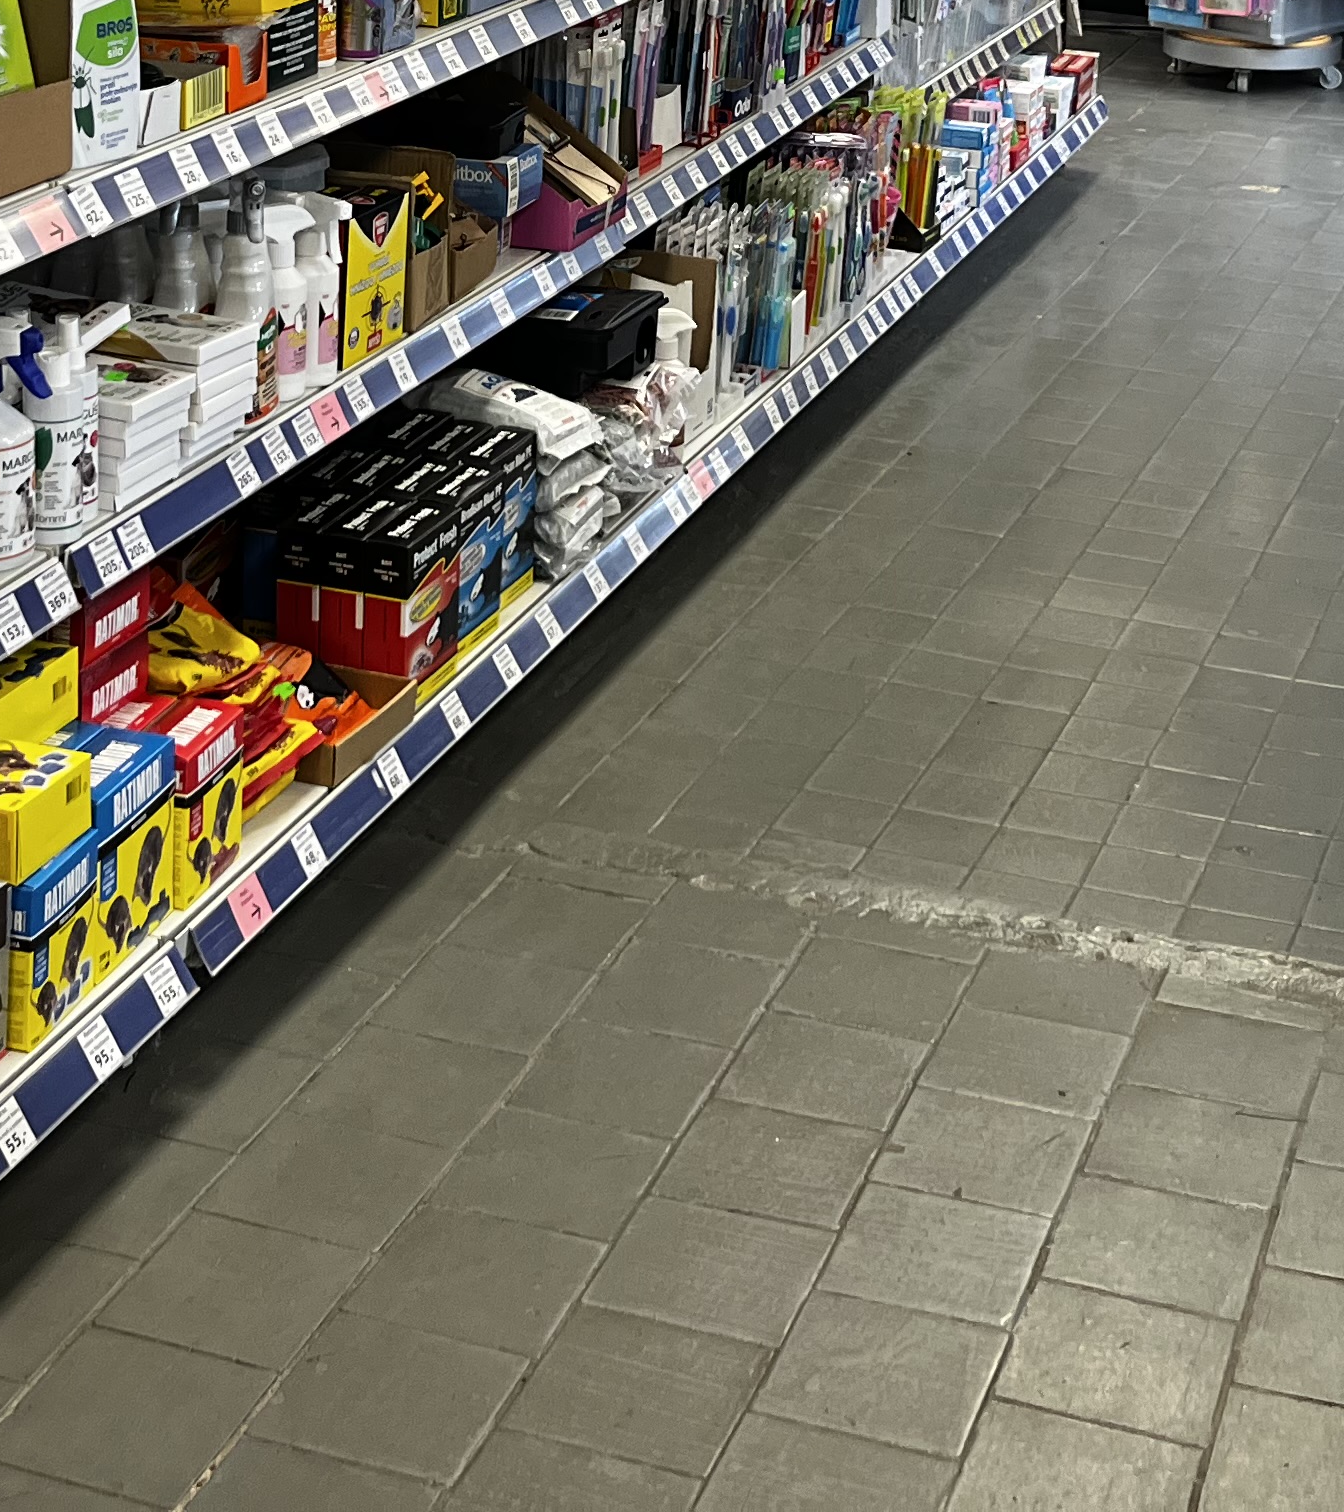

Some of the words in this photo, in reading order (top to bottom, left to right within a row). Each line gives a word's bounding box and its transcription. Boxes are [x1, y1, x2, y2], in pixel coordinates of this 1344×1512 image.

[97, 16, 135, 39] BROS
[94, 593, 141, 640] BATIMOR
[113, 759, 162, 827] BATIMOR
[45, 857, 91, 918] BATIMOR
